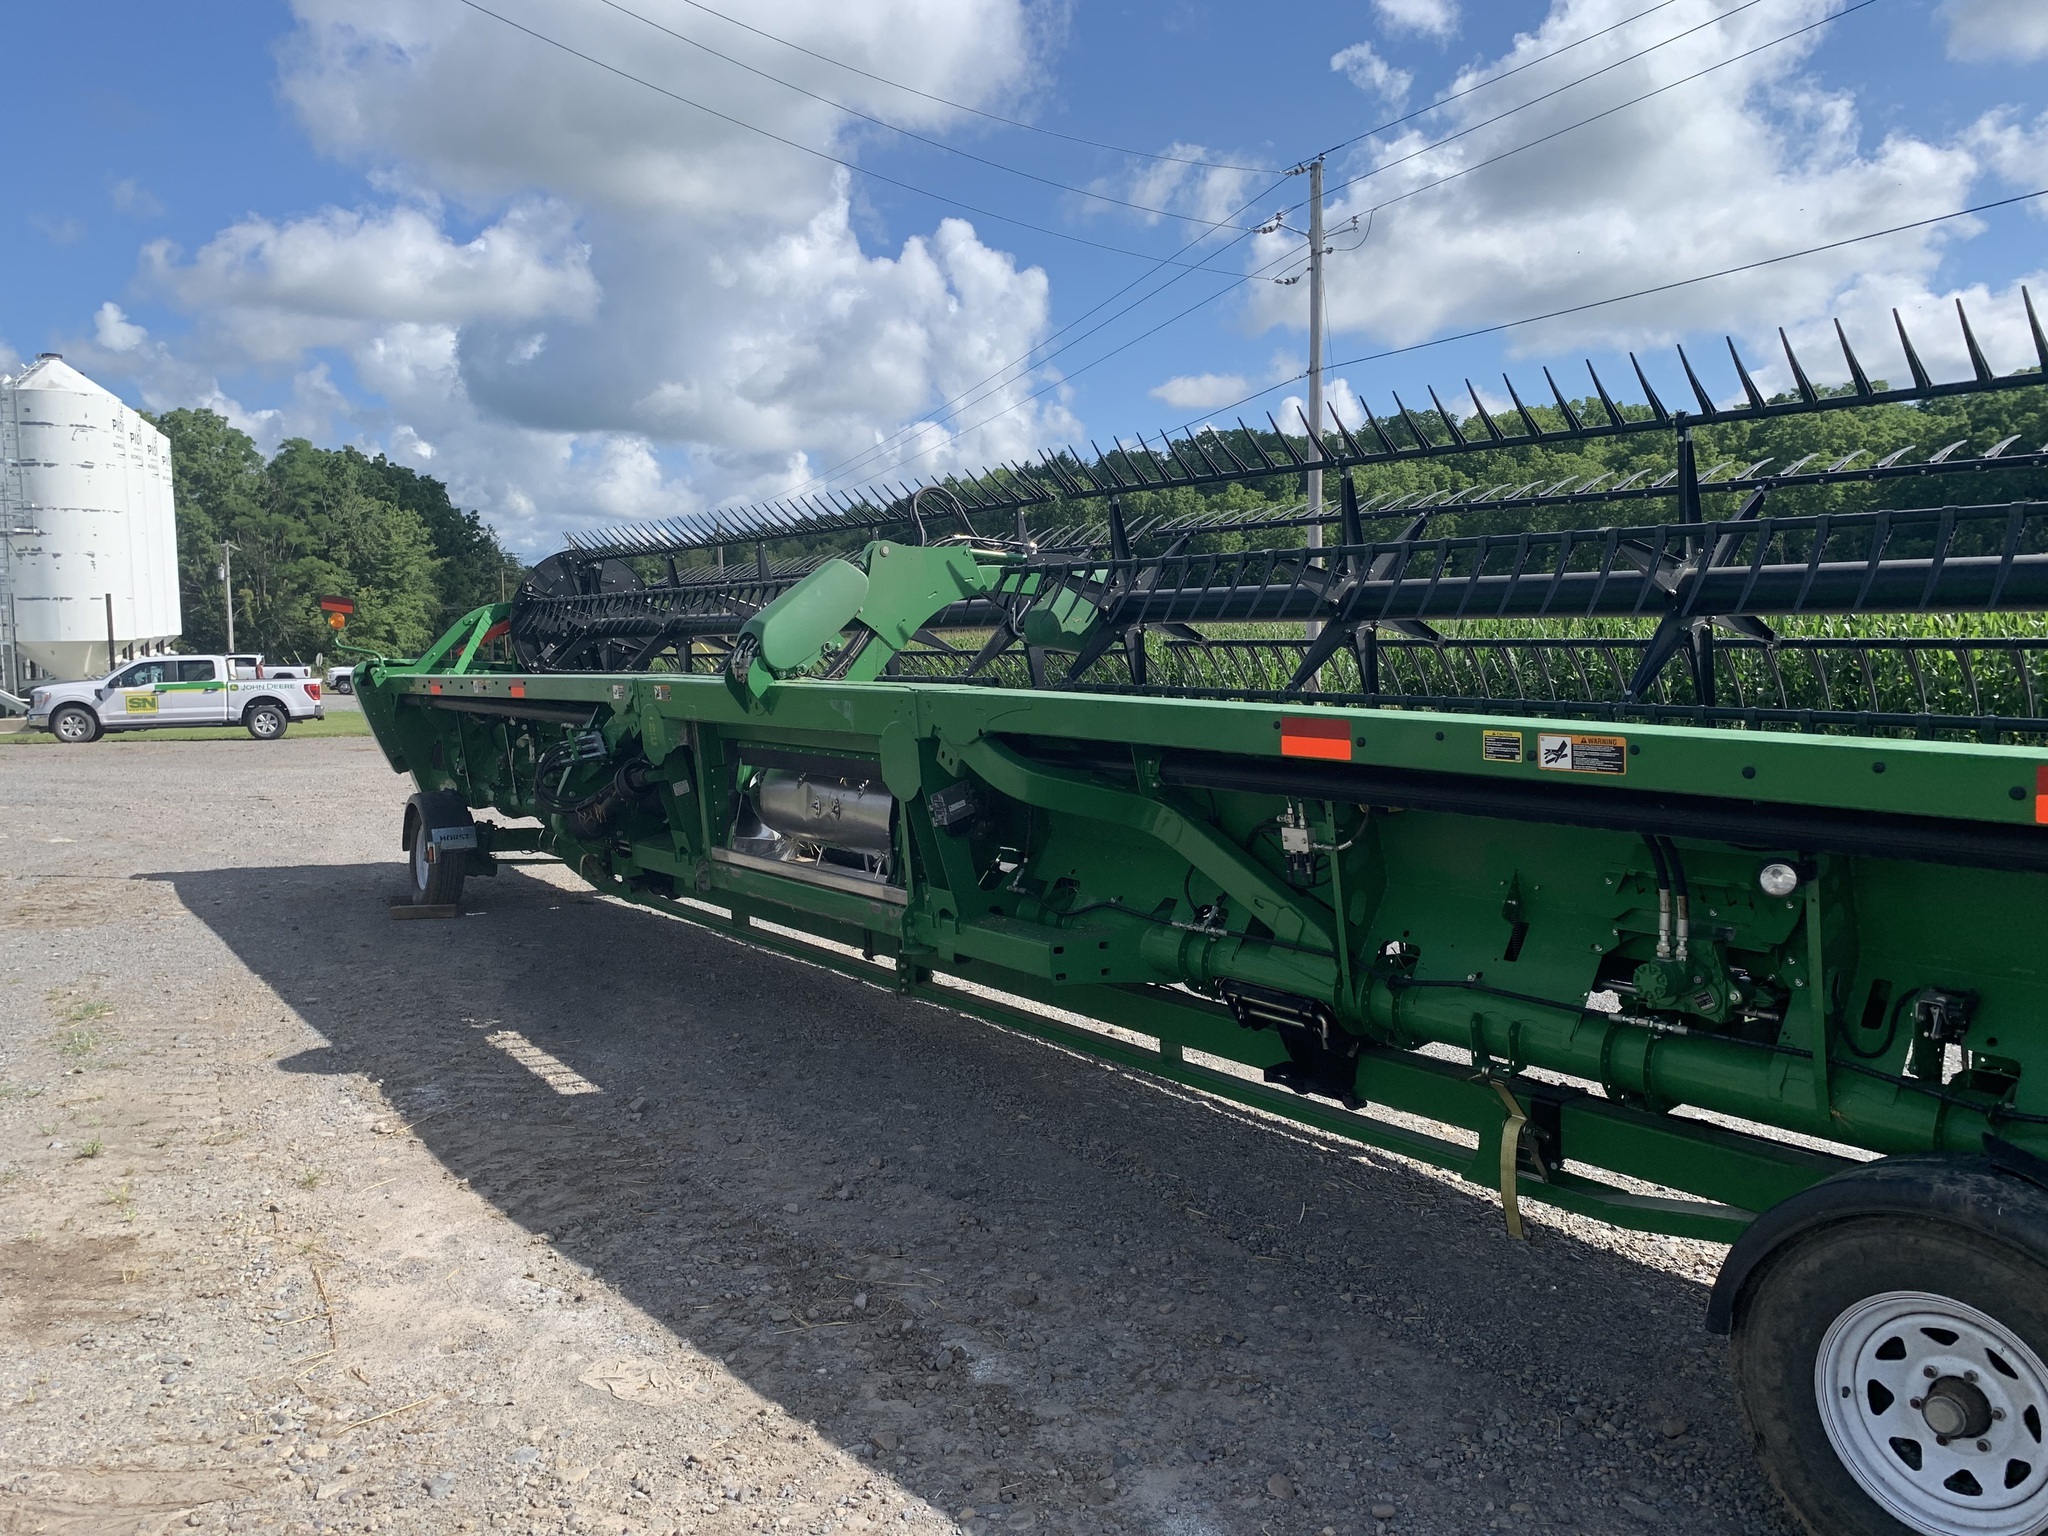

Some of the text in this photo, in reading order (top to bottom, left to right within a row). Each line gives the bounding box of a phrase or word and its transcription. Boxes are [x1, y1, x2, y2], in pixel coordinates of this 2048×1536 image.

[128, 697, 156, 709] SN
[1588, 737, 1618, 746] WARNING
[439, 833, 470, 842] HORST
